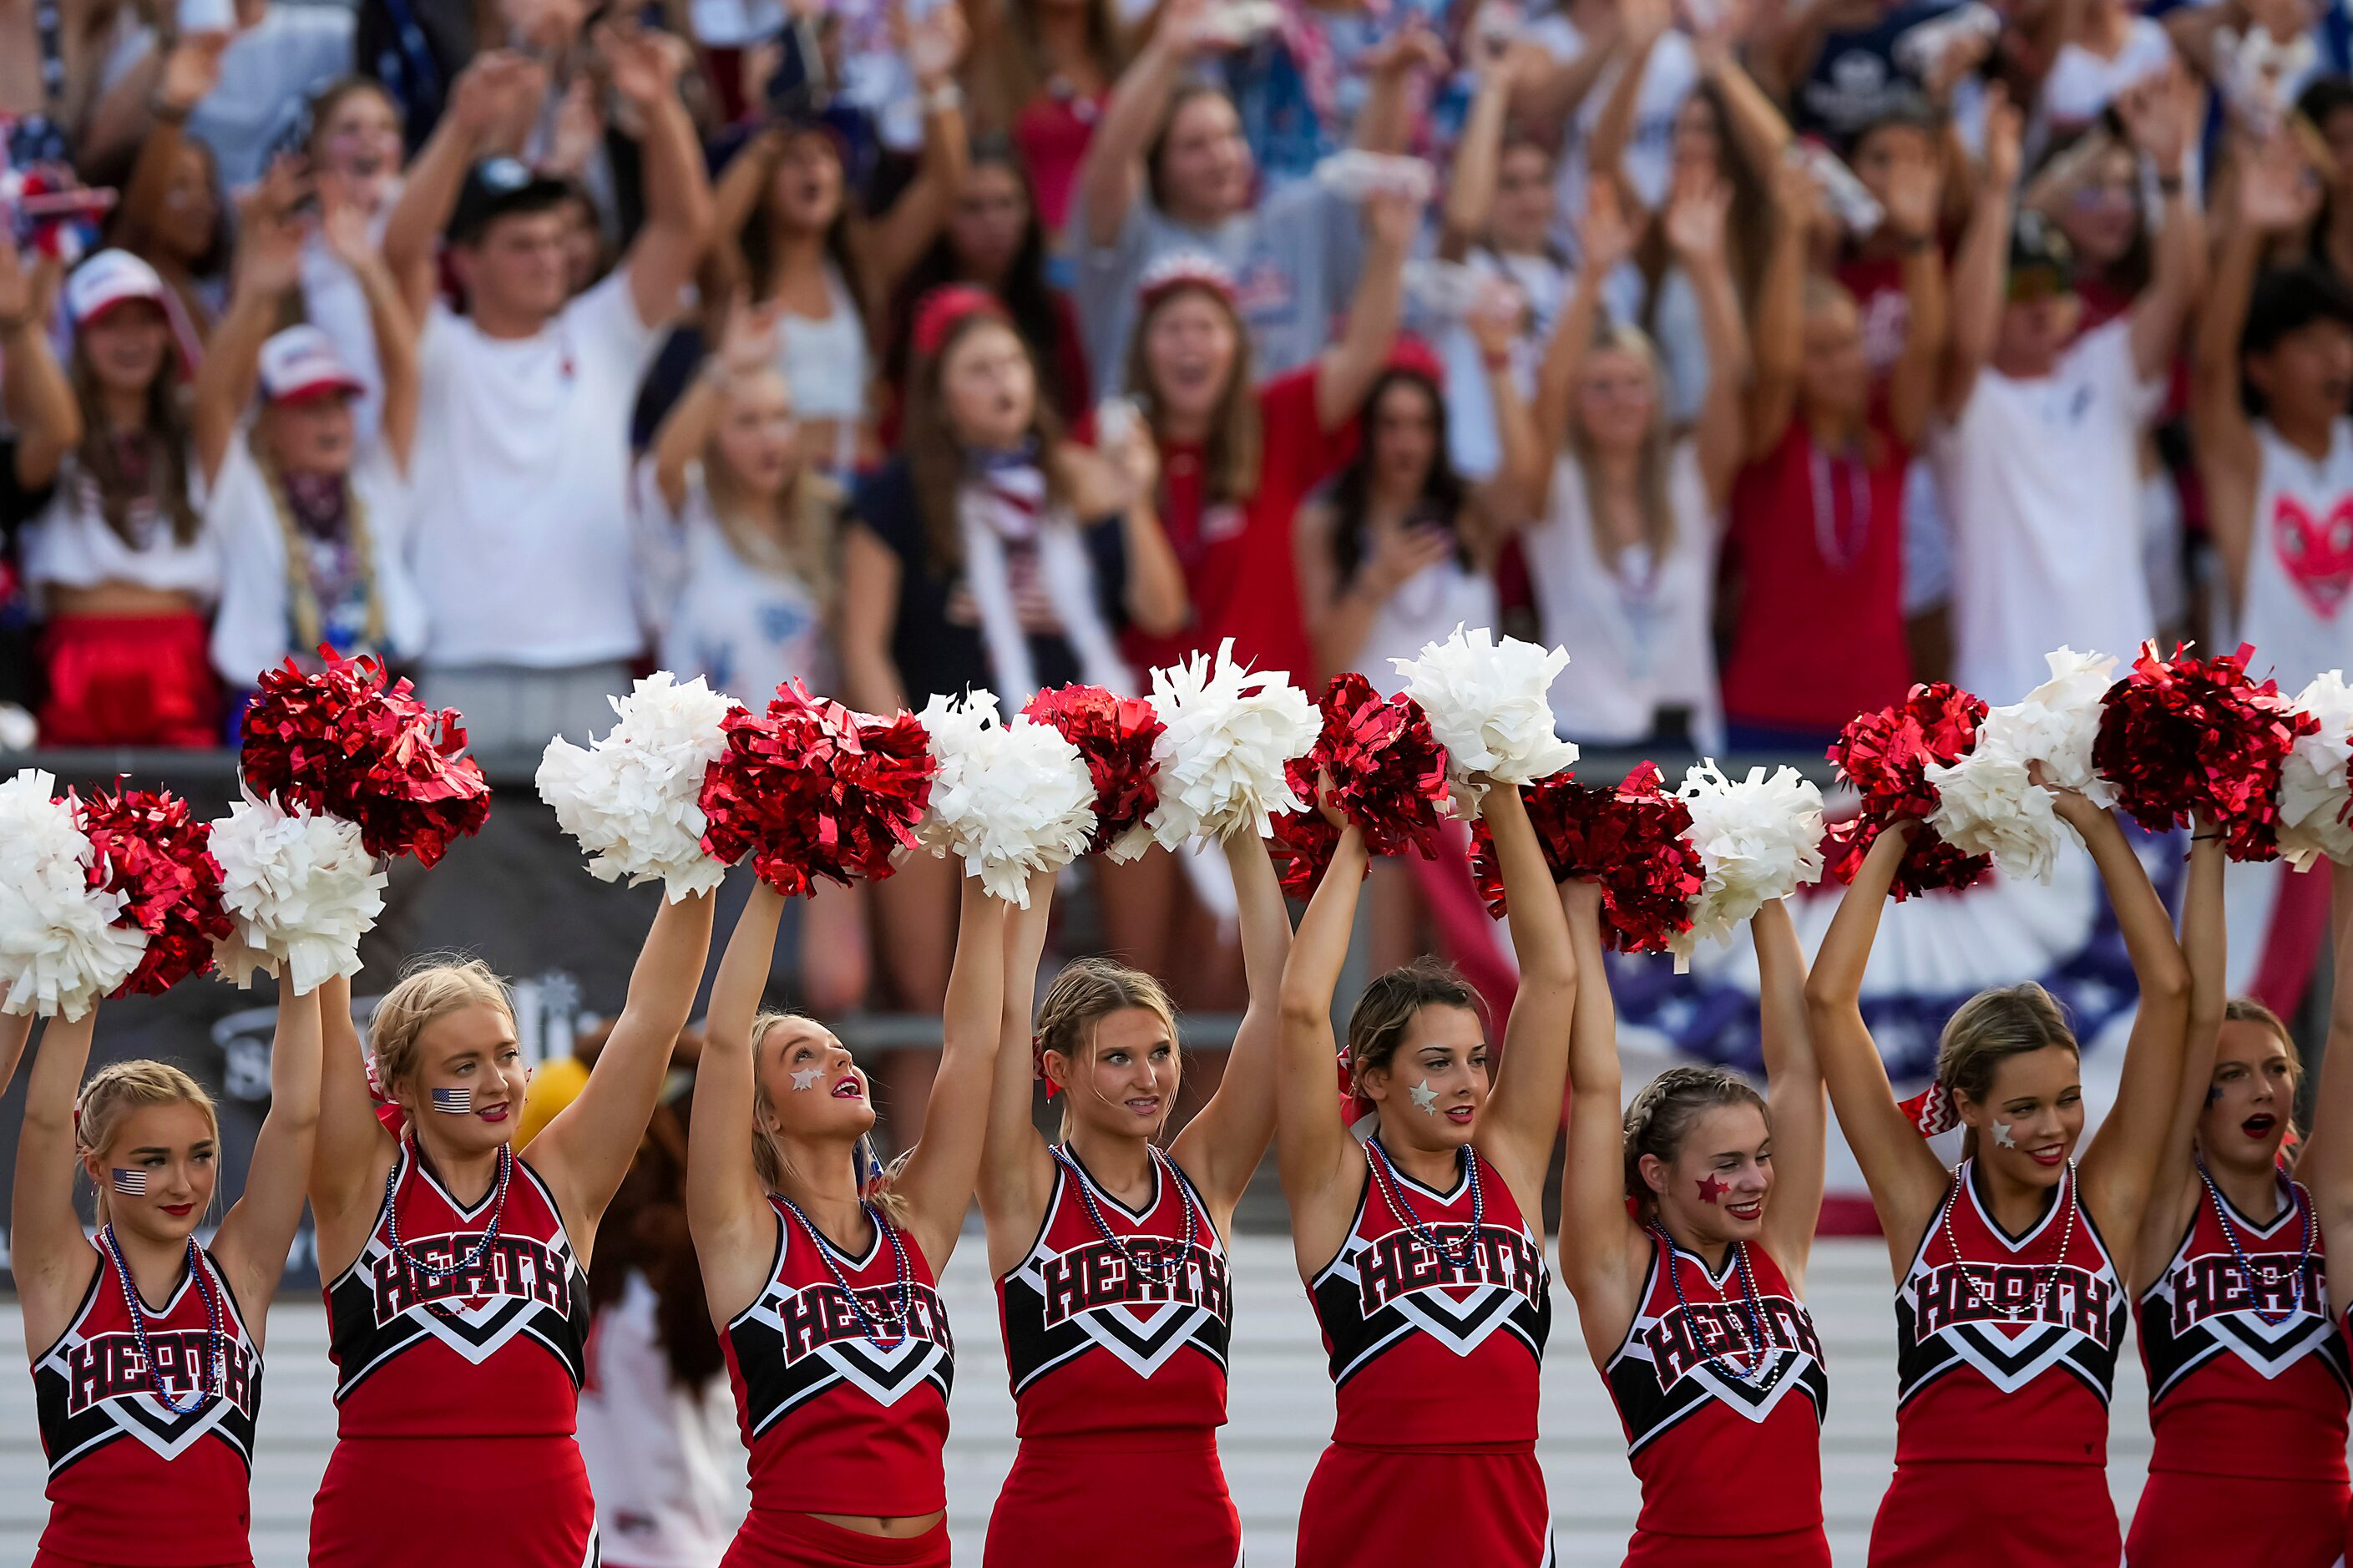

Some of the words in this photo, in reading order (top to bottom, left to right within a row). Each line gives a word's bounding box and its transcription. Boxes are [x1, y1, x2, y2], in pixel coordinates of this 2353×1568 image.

[372, 1232, 571, 1328] HEATH
[1041, 1235, 1227, 1331] HEATH
[1354, 1222, 1541, 1319] HEATH
[1915, 1262, 2111, 1351] HEATH
[2171, 1252, 2328, 1339] HEAT
[776, 1282, 956, 1368] HEATH
[1642, 1296, 1827, 1395] HEATH
[68, 1329, 250, 1419] HEATH
